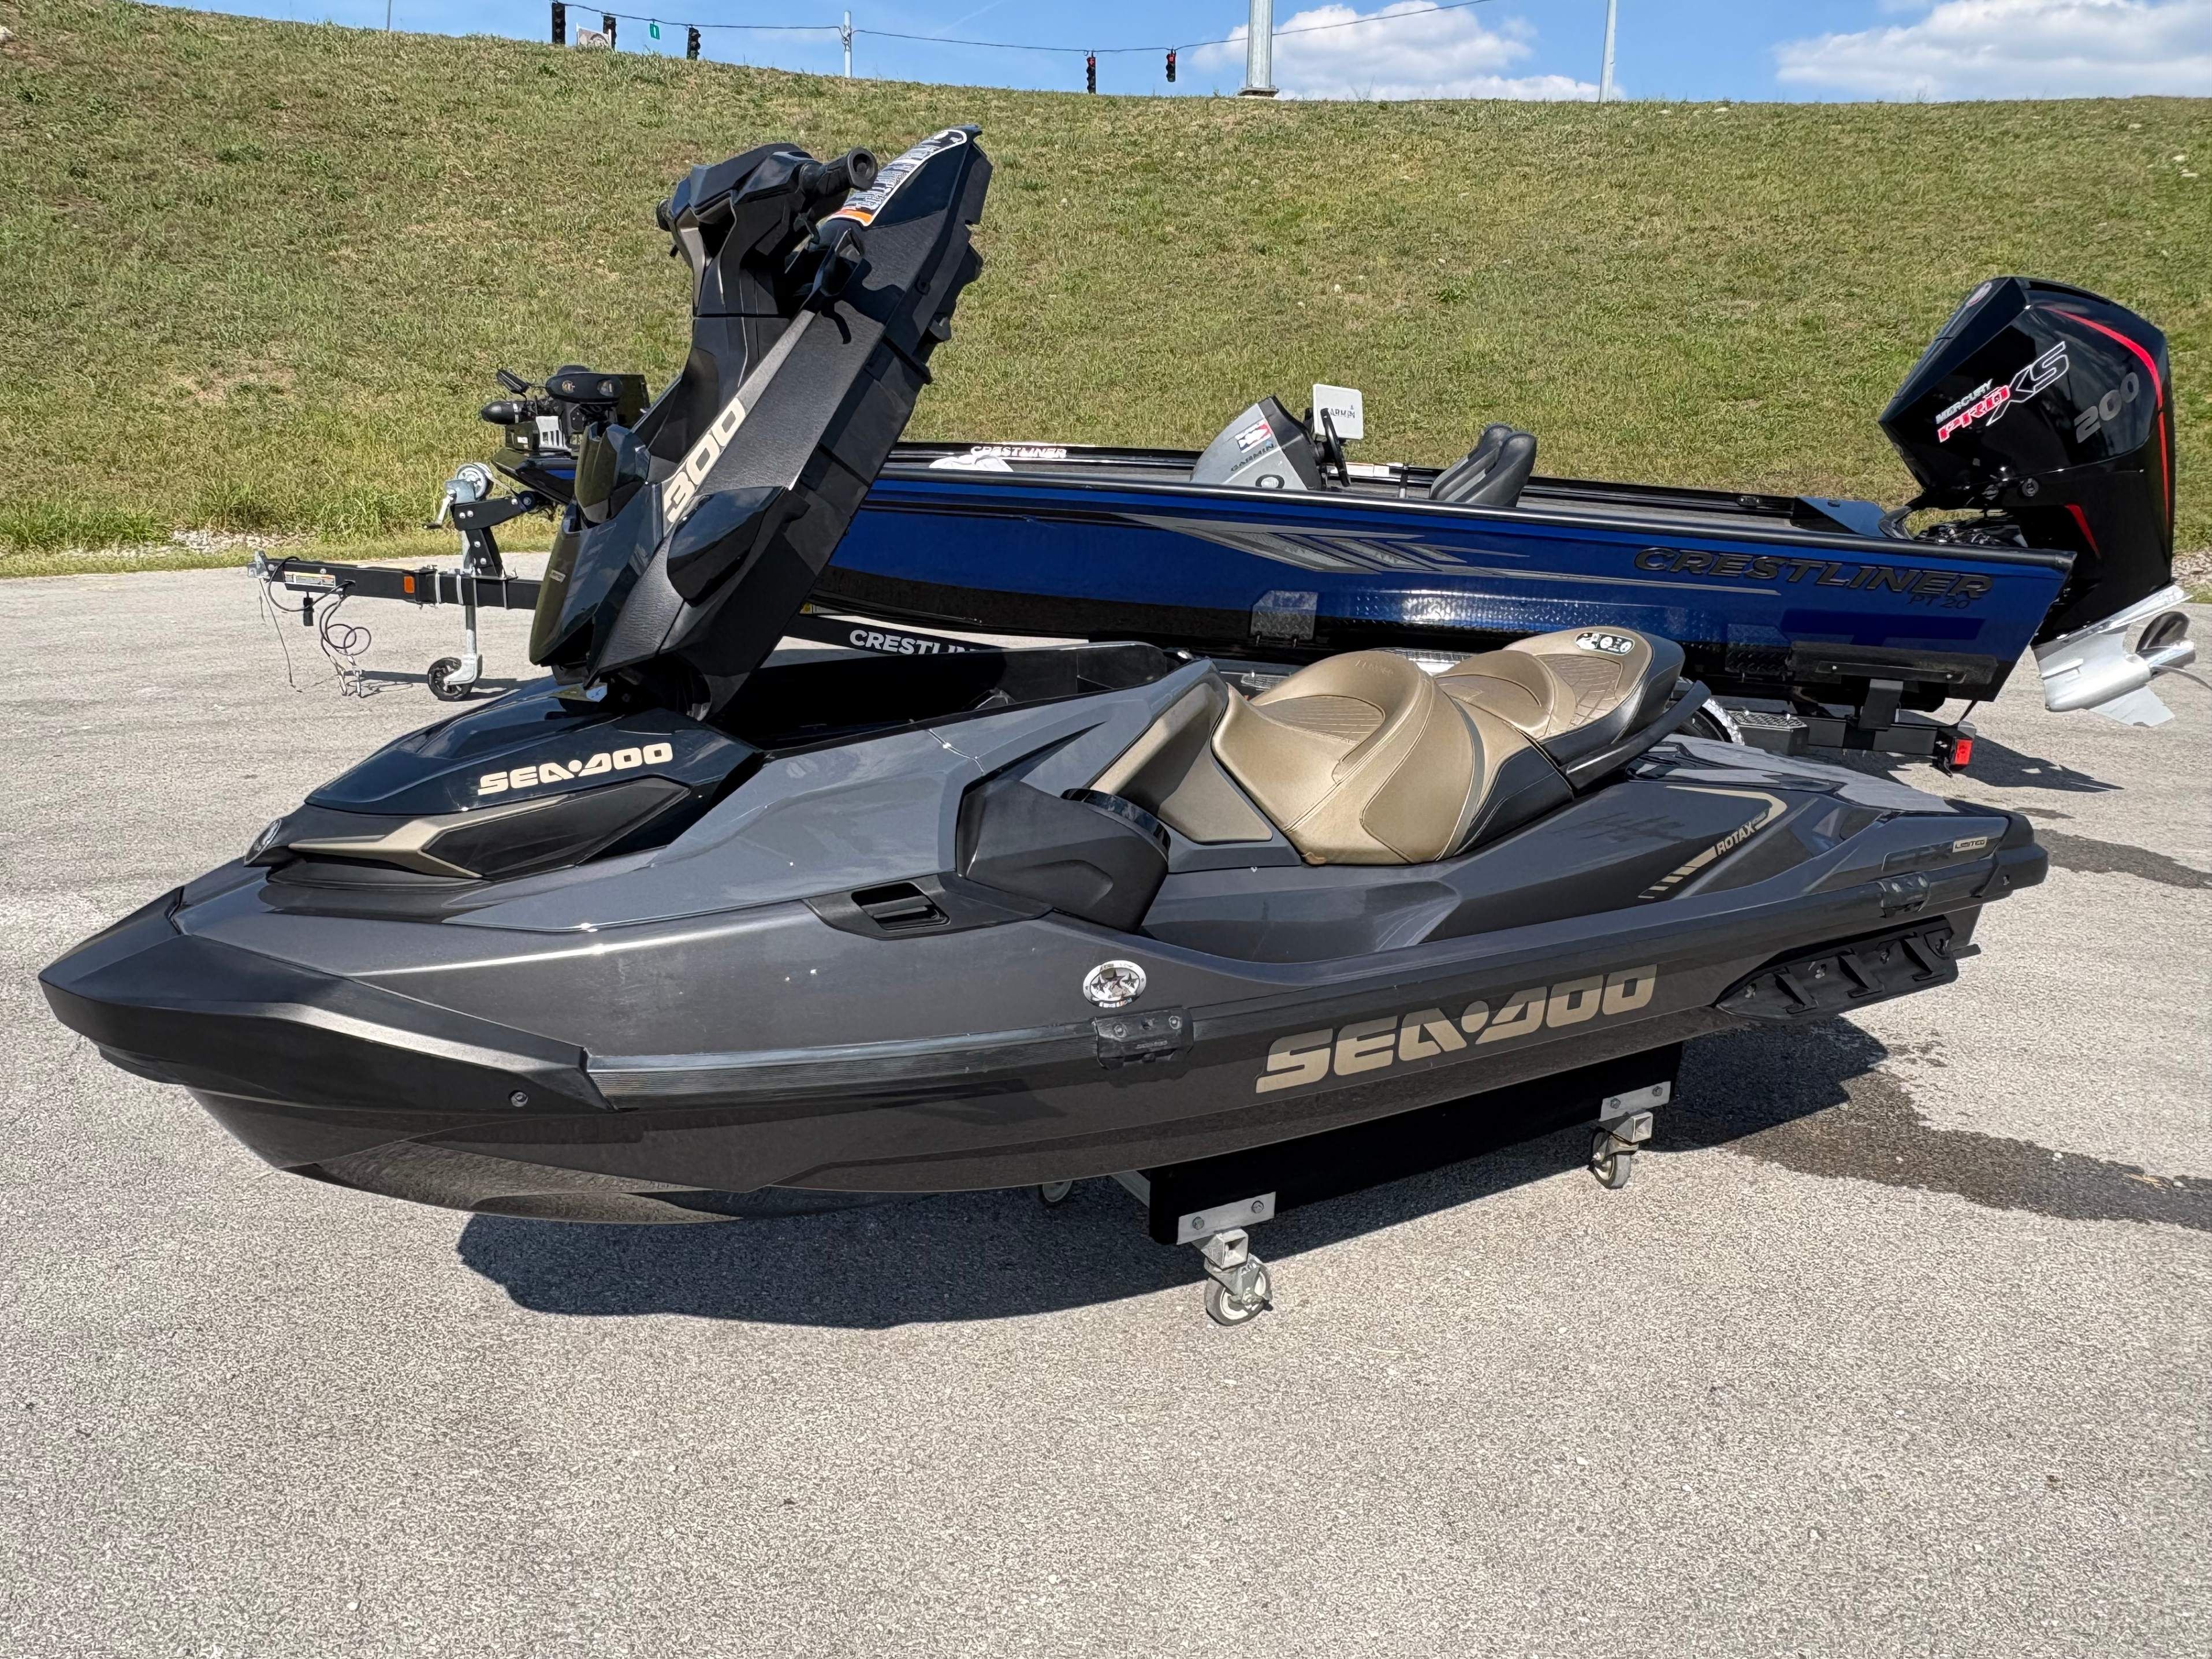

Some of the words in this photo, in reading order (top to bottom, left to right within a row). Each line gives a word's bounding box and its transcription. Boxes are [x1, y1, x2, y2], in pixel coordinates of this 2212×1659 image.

[1330, 408, 1355, 419] ARMIN
[1936, 378, 1993, 424] MERCURY
[2074, 372, 2140, 444] 200
[664, 397, 746, 522] 300
[1634, 548, 1993, 598] CRESTLINER
[1716, 821, 1755, 855] ROTAX
